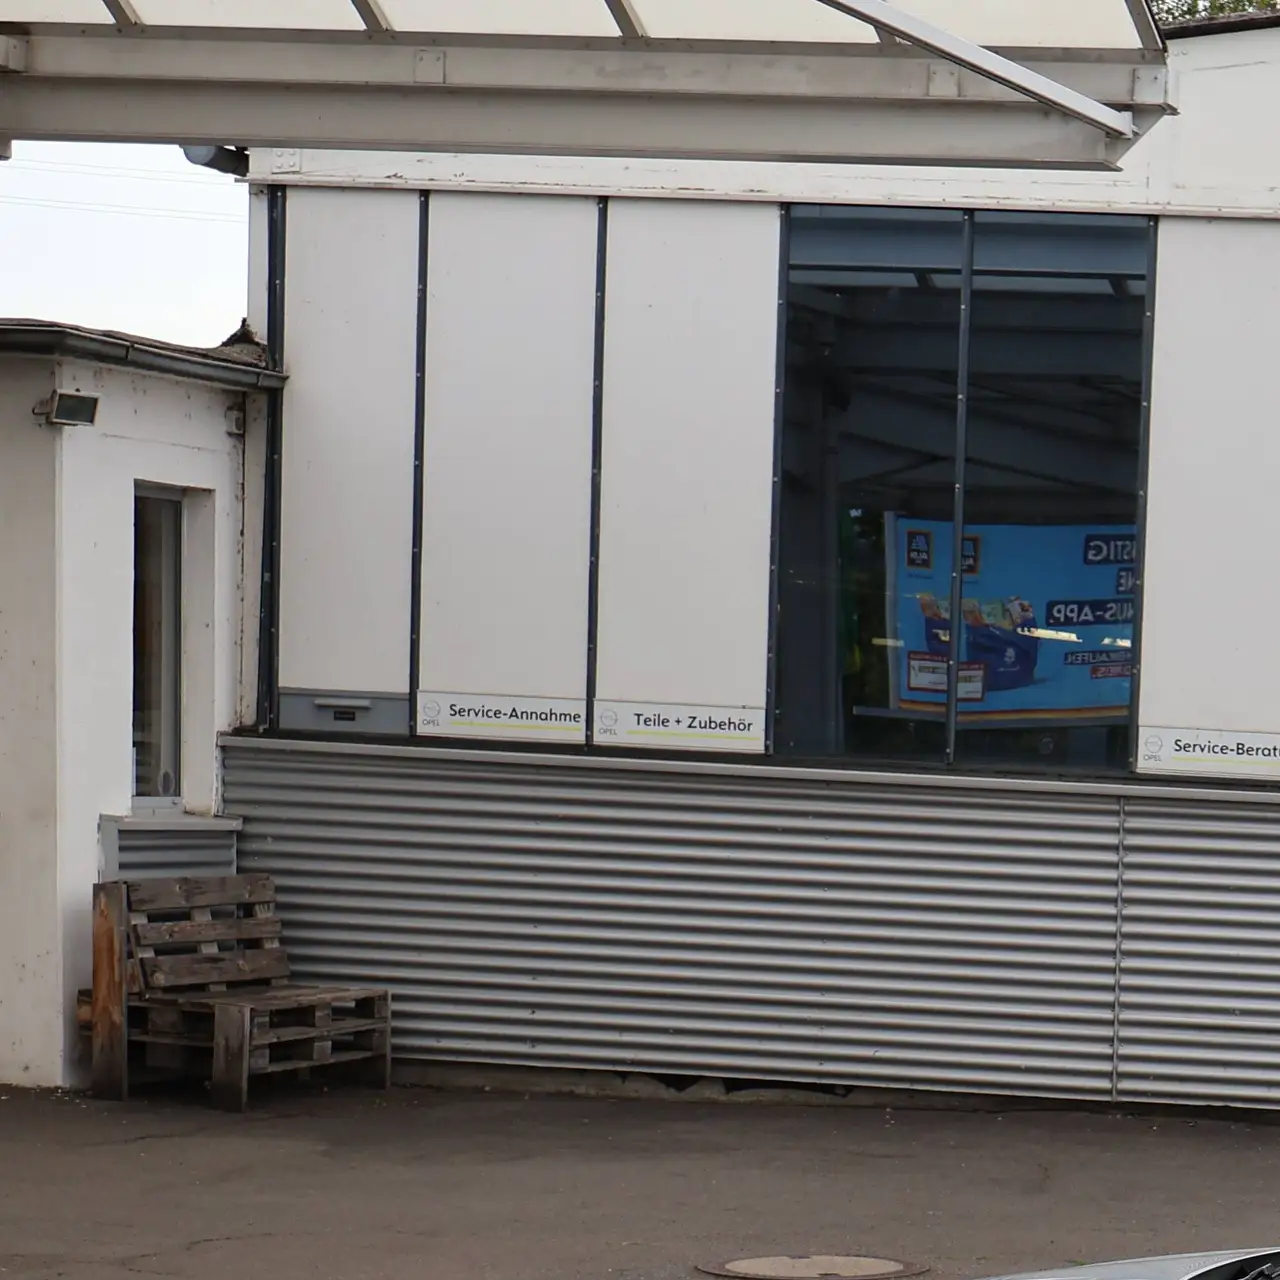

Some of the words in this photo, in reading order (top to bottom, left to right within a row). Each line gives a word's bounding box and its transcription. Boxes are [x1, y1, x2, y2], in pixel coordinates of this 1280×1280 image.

[449, 703, 581, 723] Service-Annahme
[422, 719, 440, 727] OPEL
[633, 713, 670, 727] Teile
[674, 718, 682, 726] +
[687, 715, 753, 732] Zubehör
[598, 728, 617, 736] OPEL
